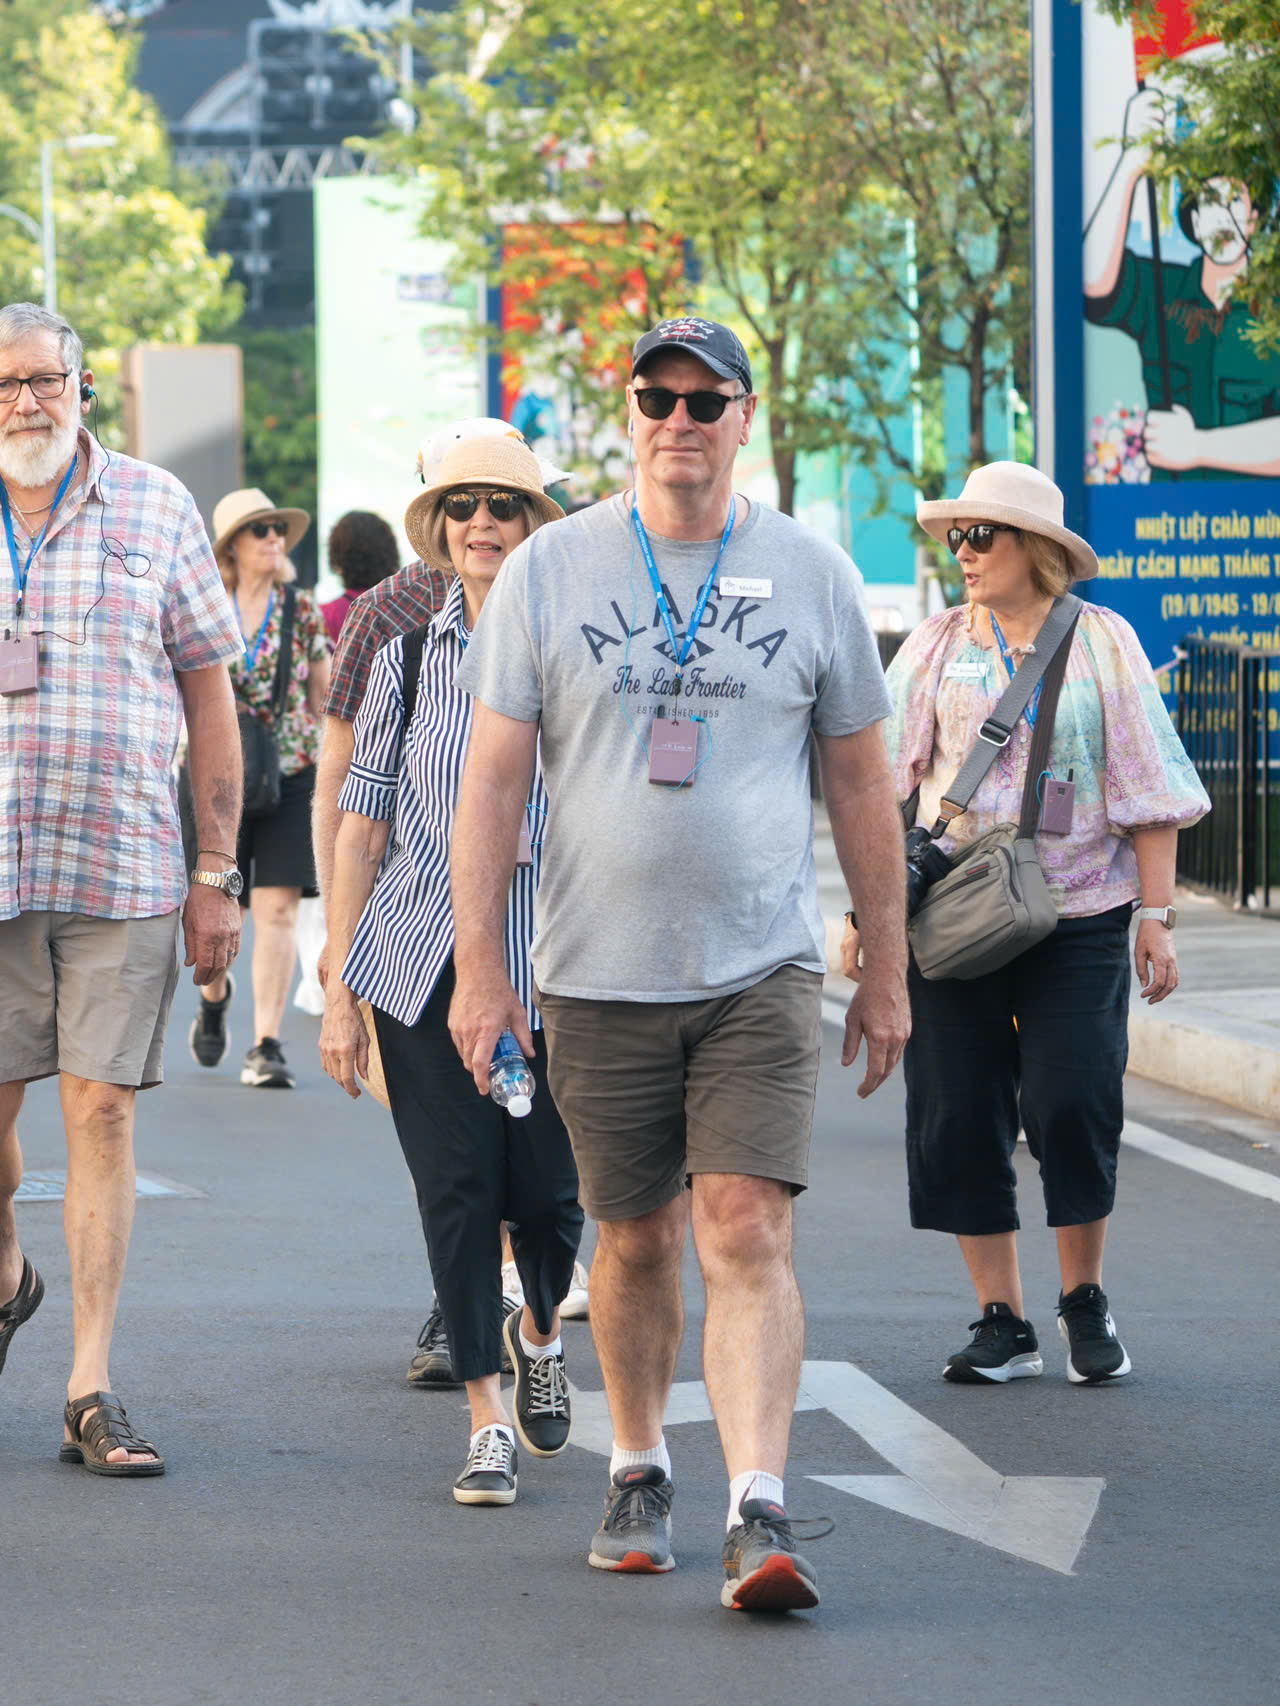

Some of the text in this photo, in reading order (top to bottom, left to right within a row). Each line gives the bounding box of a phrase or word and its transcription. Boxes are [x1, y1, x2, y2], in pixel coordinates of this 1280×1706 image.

[1135, 511, 1176, 544] NHIỆT
[1179, 511, 1207, 544] LIỆT
[1211, 509, 1250, 539] CHÀO
[1137, 549, 1176, 579] CÁCH
[1179, 555, 1220, 582] MẠNG
[1223, 549, 1270, 578] THÁNG
[1161, 592, 1239, 621] (19/8/1945
[580, 583, 788, 669] ALASKA
[612, 664, 746, 699] The Las Frontier
[637, 705, 693, 718] ESTAISHED
